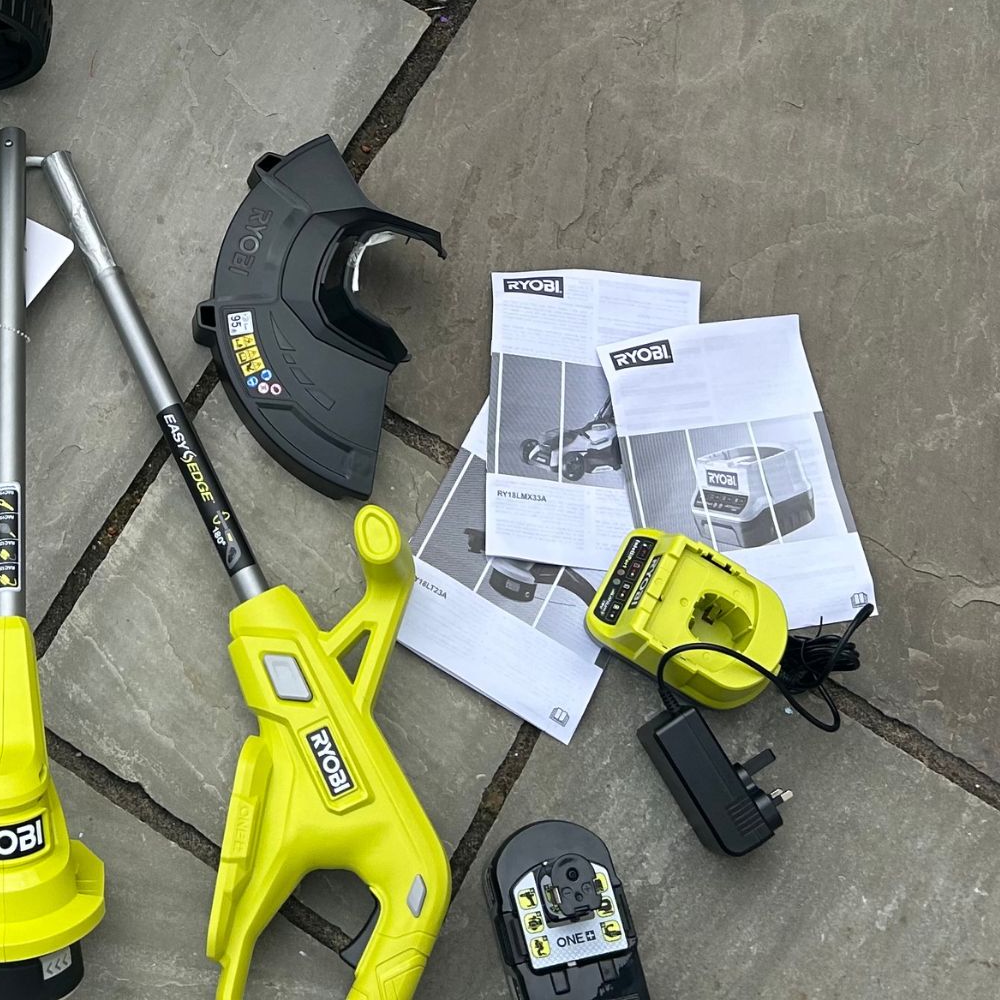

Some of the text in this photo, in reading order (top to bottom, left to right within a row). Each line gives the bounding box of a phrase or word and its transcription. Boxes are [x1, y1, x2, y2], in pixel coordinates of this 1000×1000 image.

[228, 207, 273, 277] RYOBI
[506, 279, 563, 294] RYOBI
[230, 314, 242, 328] 95
[613, 343, 672, 367] RYOBI
[163, 413, 214, 502] EASY EDGE
[707, 472, 737, 487] RYOBI
[496, 489, 547, 502] RY18LMX33A
[414, 576, 448, 599] Y18LT23A
[631, 557, 659, 606] RYOBI
[310, 728, 351, 795] RYOBI
